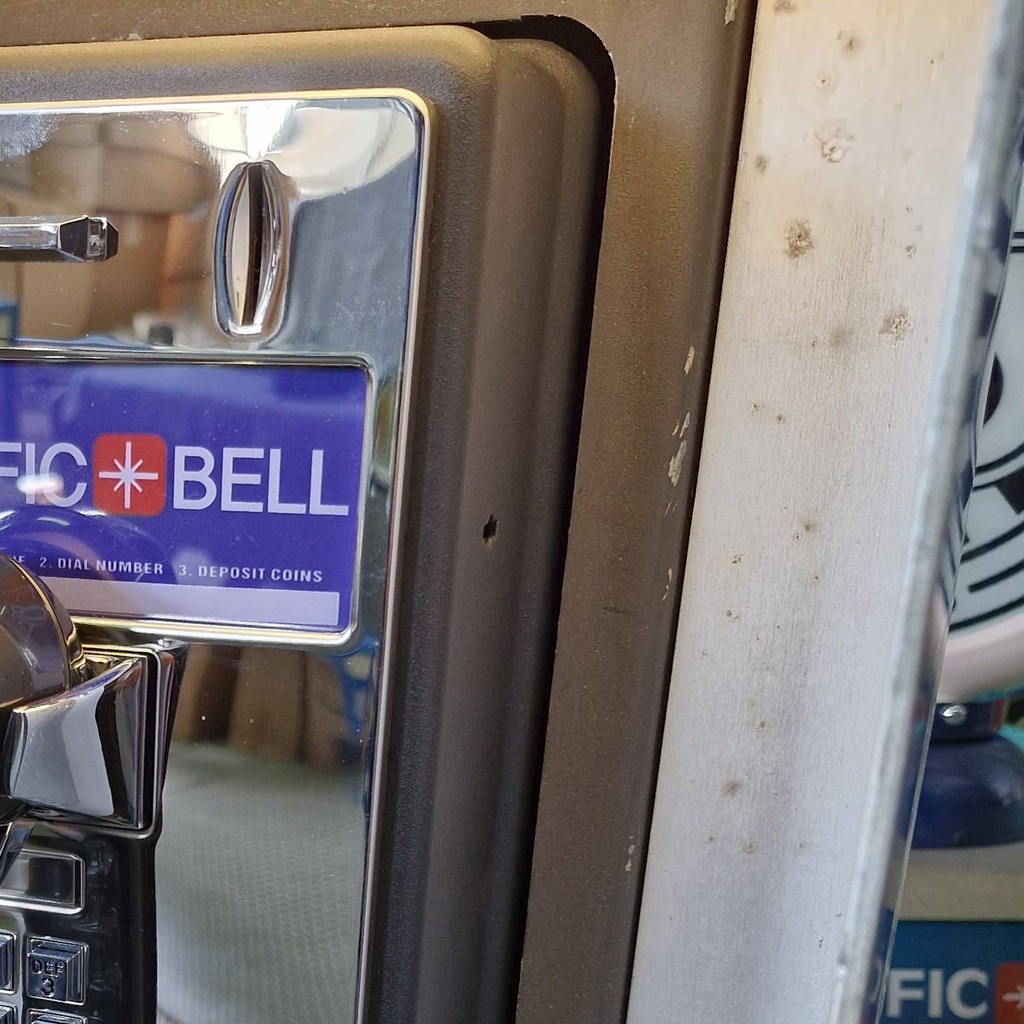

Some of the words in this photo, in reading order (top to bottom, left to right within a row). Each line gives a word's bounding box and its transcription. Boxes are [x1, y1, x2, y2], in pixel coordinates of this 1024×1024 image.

[173, 445, 349, 516] BELL
[39, 556, 54, 569] 2.
[58, 558, 91, 571] DIAL
[96, 559, 164, 575] NUMBER
[179, 564, 194, 577] 3.
[198, 566, 265, 580] DEPOSIT
[271, 569, 323, 583] COINS
